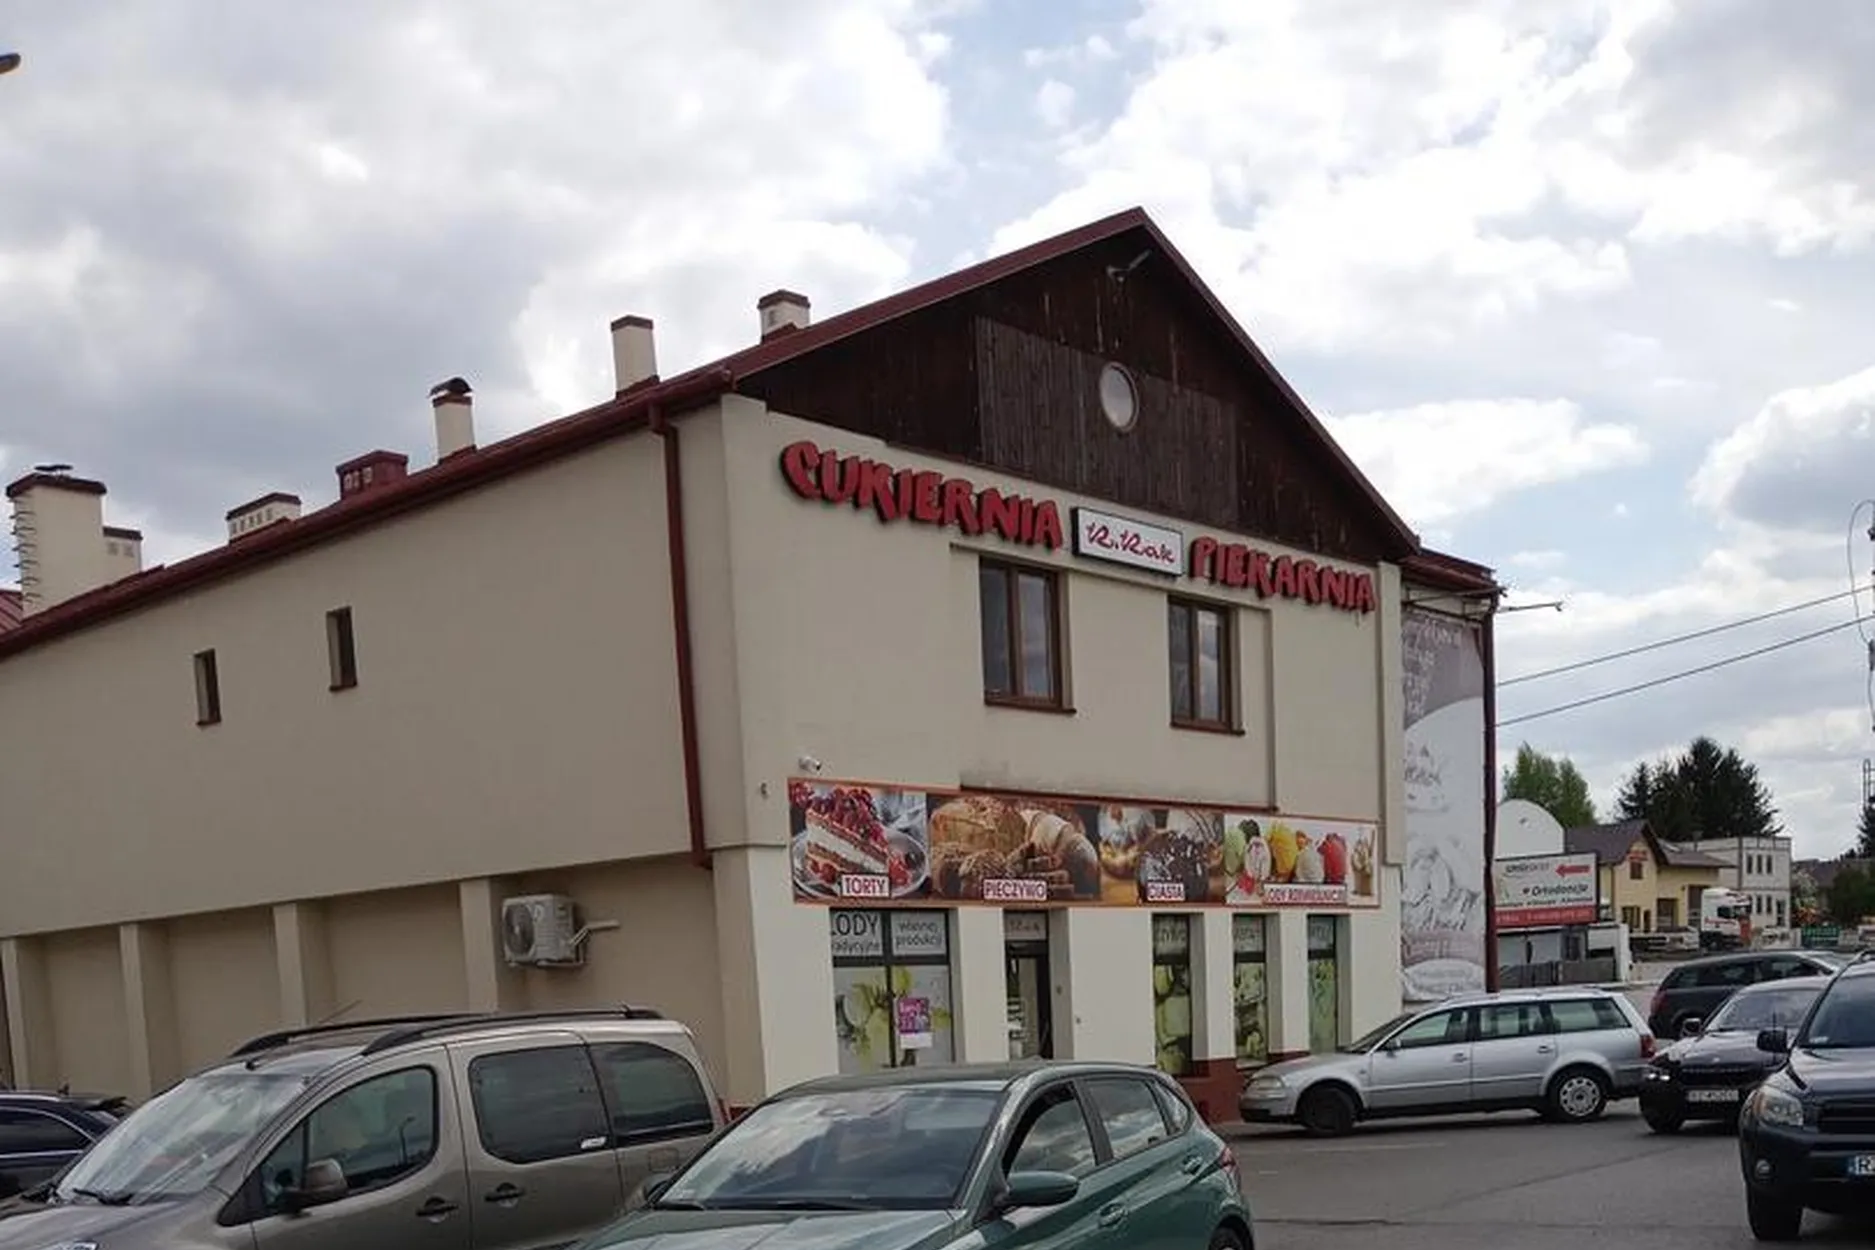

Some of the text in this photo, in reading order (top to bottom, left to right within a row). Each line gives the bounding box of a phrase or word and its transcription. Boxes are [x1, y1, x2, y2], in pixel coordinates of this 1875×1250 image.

[781, 441, 1063, 550] CUKIERNIA
[1190, 536, 1374, 613] PIEKARNIA
[844, 877, 886, 895] TORTY
[983, 880, 1046, 898] PIECZYWO
